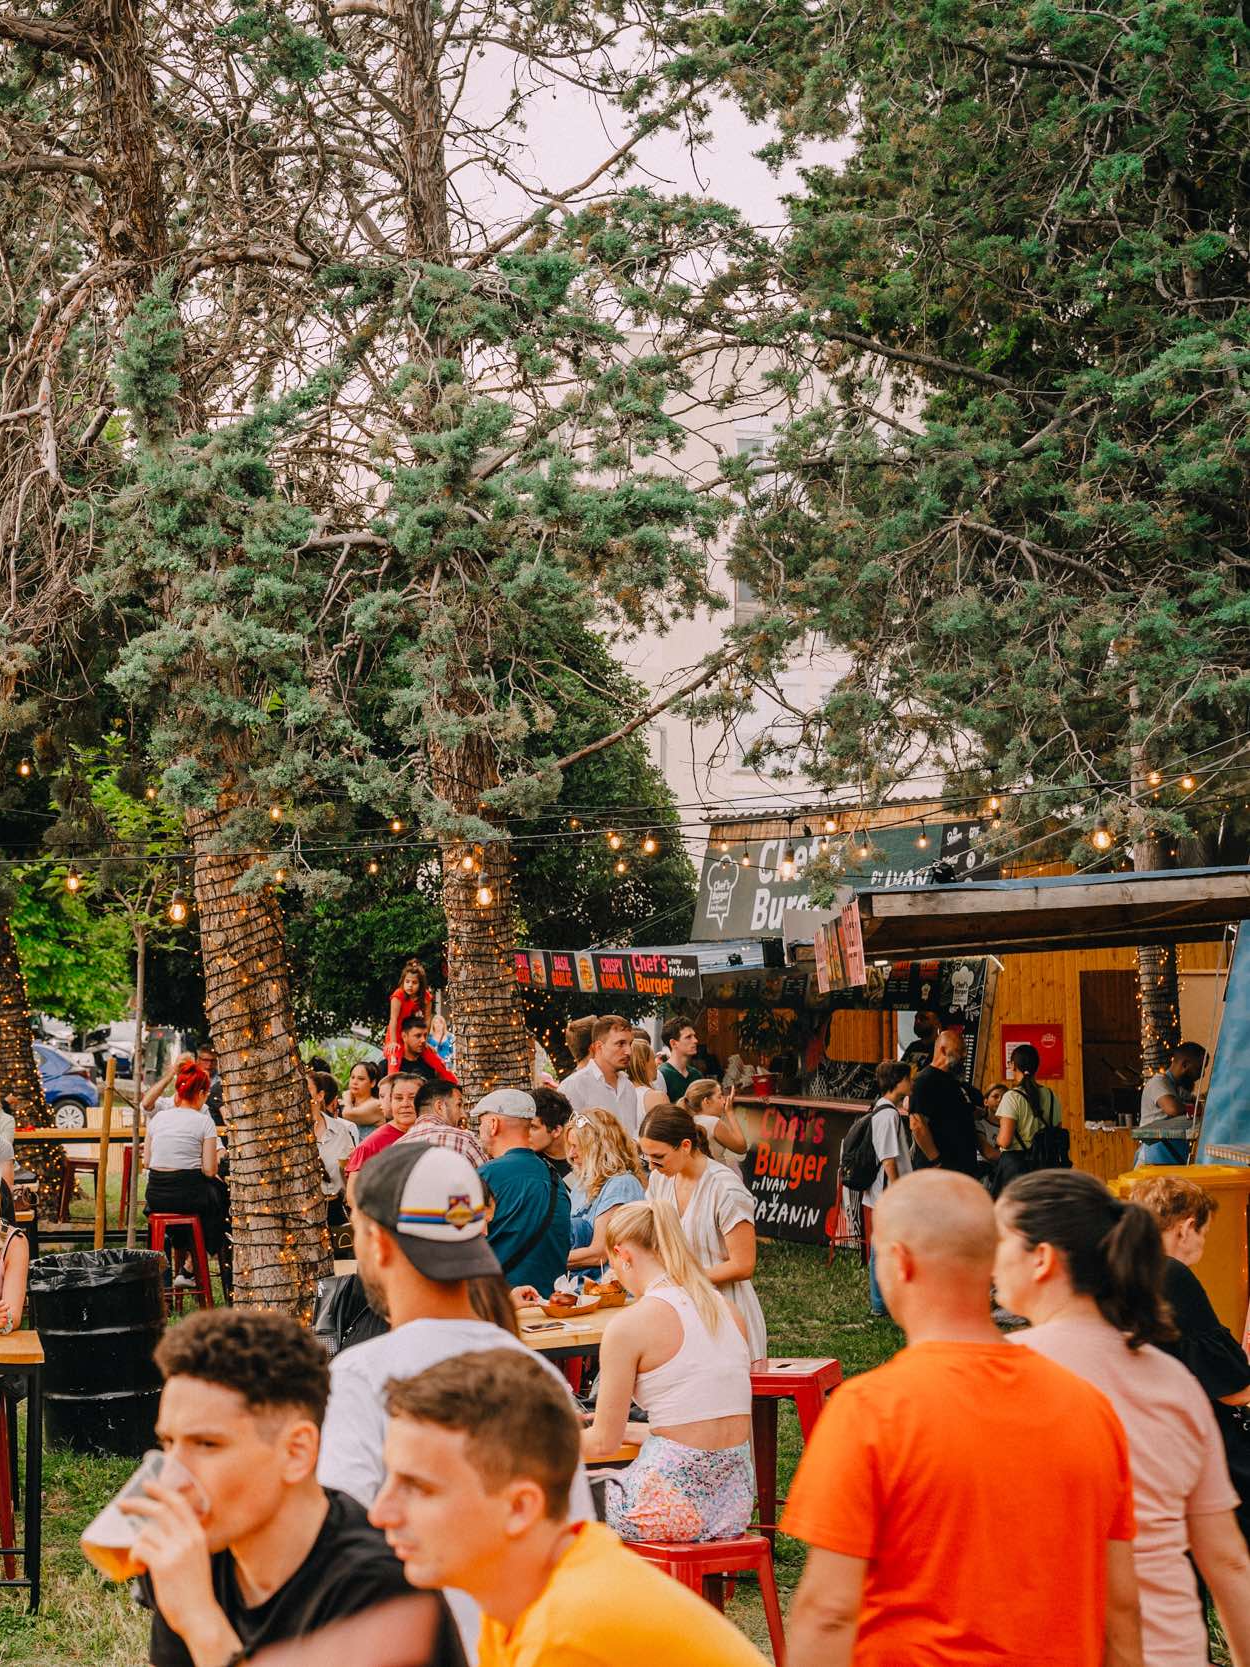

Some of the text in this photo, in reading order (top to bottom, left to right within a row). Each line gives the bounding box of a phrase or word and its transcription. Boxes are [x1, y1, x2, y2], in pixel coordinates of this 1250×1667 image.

[600, 958, 623, 974] CRISPY
[631, 953, 668, 973] Chef's
[635, 973, 674, 997] Burger
[754, 1142, 827, 1190] Burger
[760, 1175, 788, 1192] IVAN
